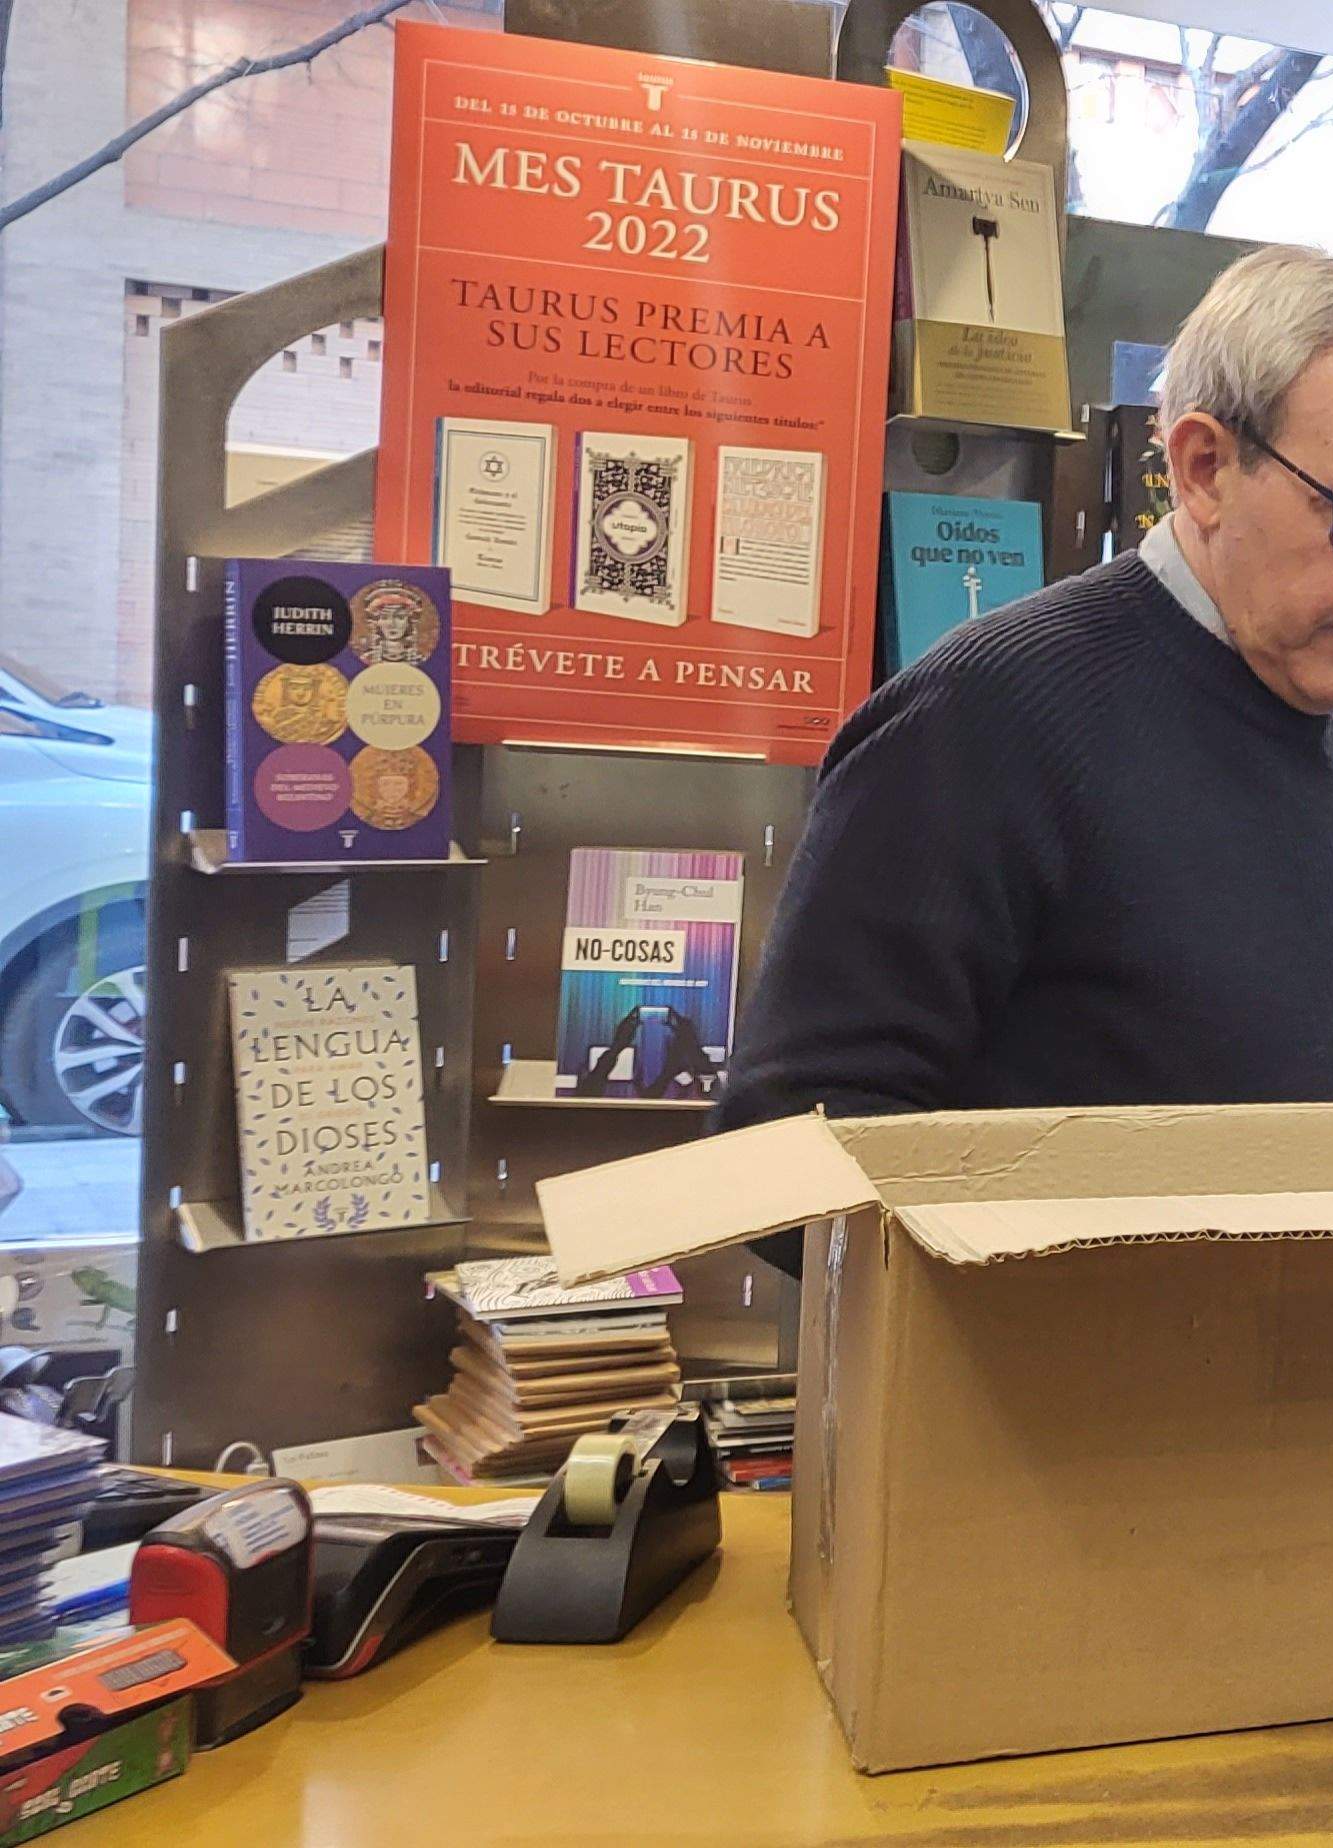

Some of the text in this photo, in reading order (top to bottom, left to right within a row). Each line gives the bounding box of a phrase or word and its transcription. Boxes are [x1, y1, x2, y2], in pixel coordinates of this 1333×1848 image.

[456, 95, 492, 113] DEL
[524, 106, 549, 122] DE
[556, 110, 642, 133] OCTUBRE
[649, 123, 674, 138] AL
[705, 130, 729, 146] DE
[736, 133, 844, 161] NOVIEMBRE
[452, 142, 841, 233] MES TAURUS
[923, 176, 1003, 210] Amartya
[1010, 191, 1040, 213] Sen
[582, 211, 711, 263] 2022
[451, 278, 831, 349] TAURUS PREMIA A
[486, 320, 794, 380] SUS LECTORES
[912, 546, 1024, 567] que no ven
[274, 606, 333, 620] JUDITH
[272, 621, 334, 636] HERRIN
[452, 642, 814, 693] TRÉVETE A PENSAR
[362, 684, 424, 697] MUJERES
[384, 699, 403, 710] EN
[635, 884, 714, 899] Byung-Chul
[633, 902, 663, 913] Han
[575, 938, 674, 963] NO-COSAS
[306, 987, 352, 1012] LA
[252, 1030, 405, 1062] LENGUA
[271, 1074, 397, 1109] DE LOS
[276, 1120, 398, 1156] DIOSES
[304, 1161, 374, 1178] ANDREA
[275, 1172, 404, 1196] MARCOLONGO
